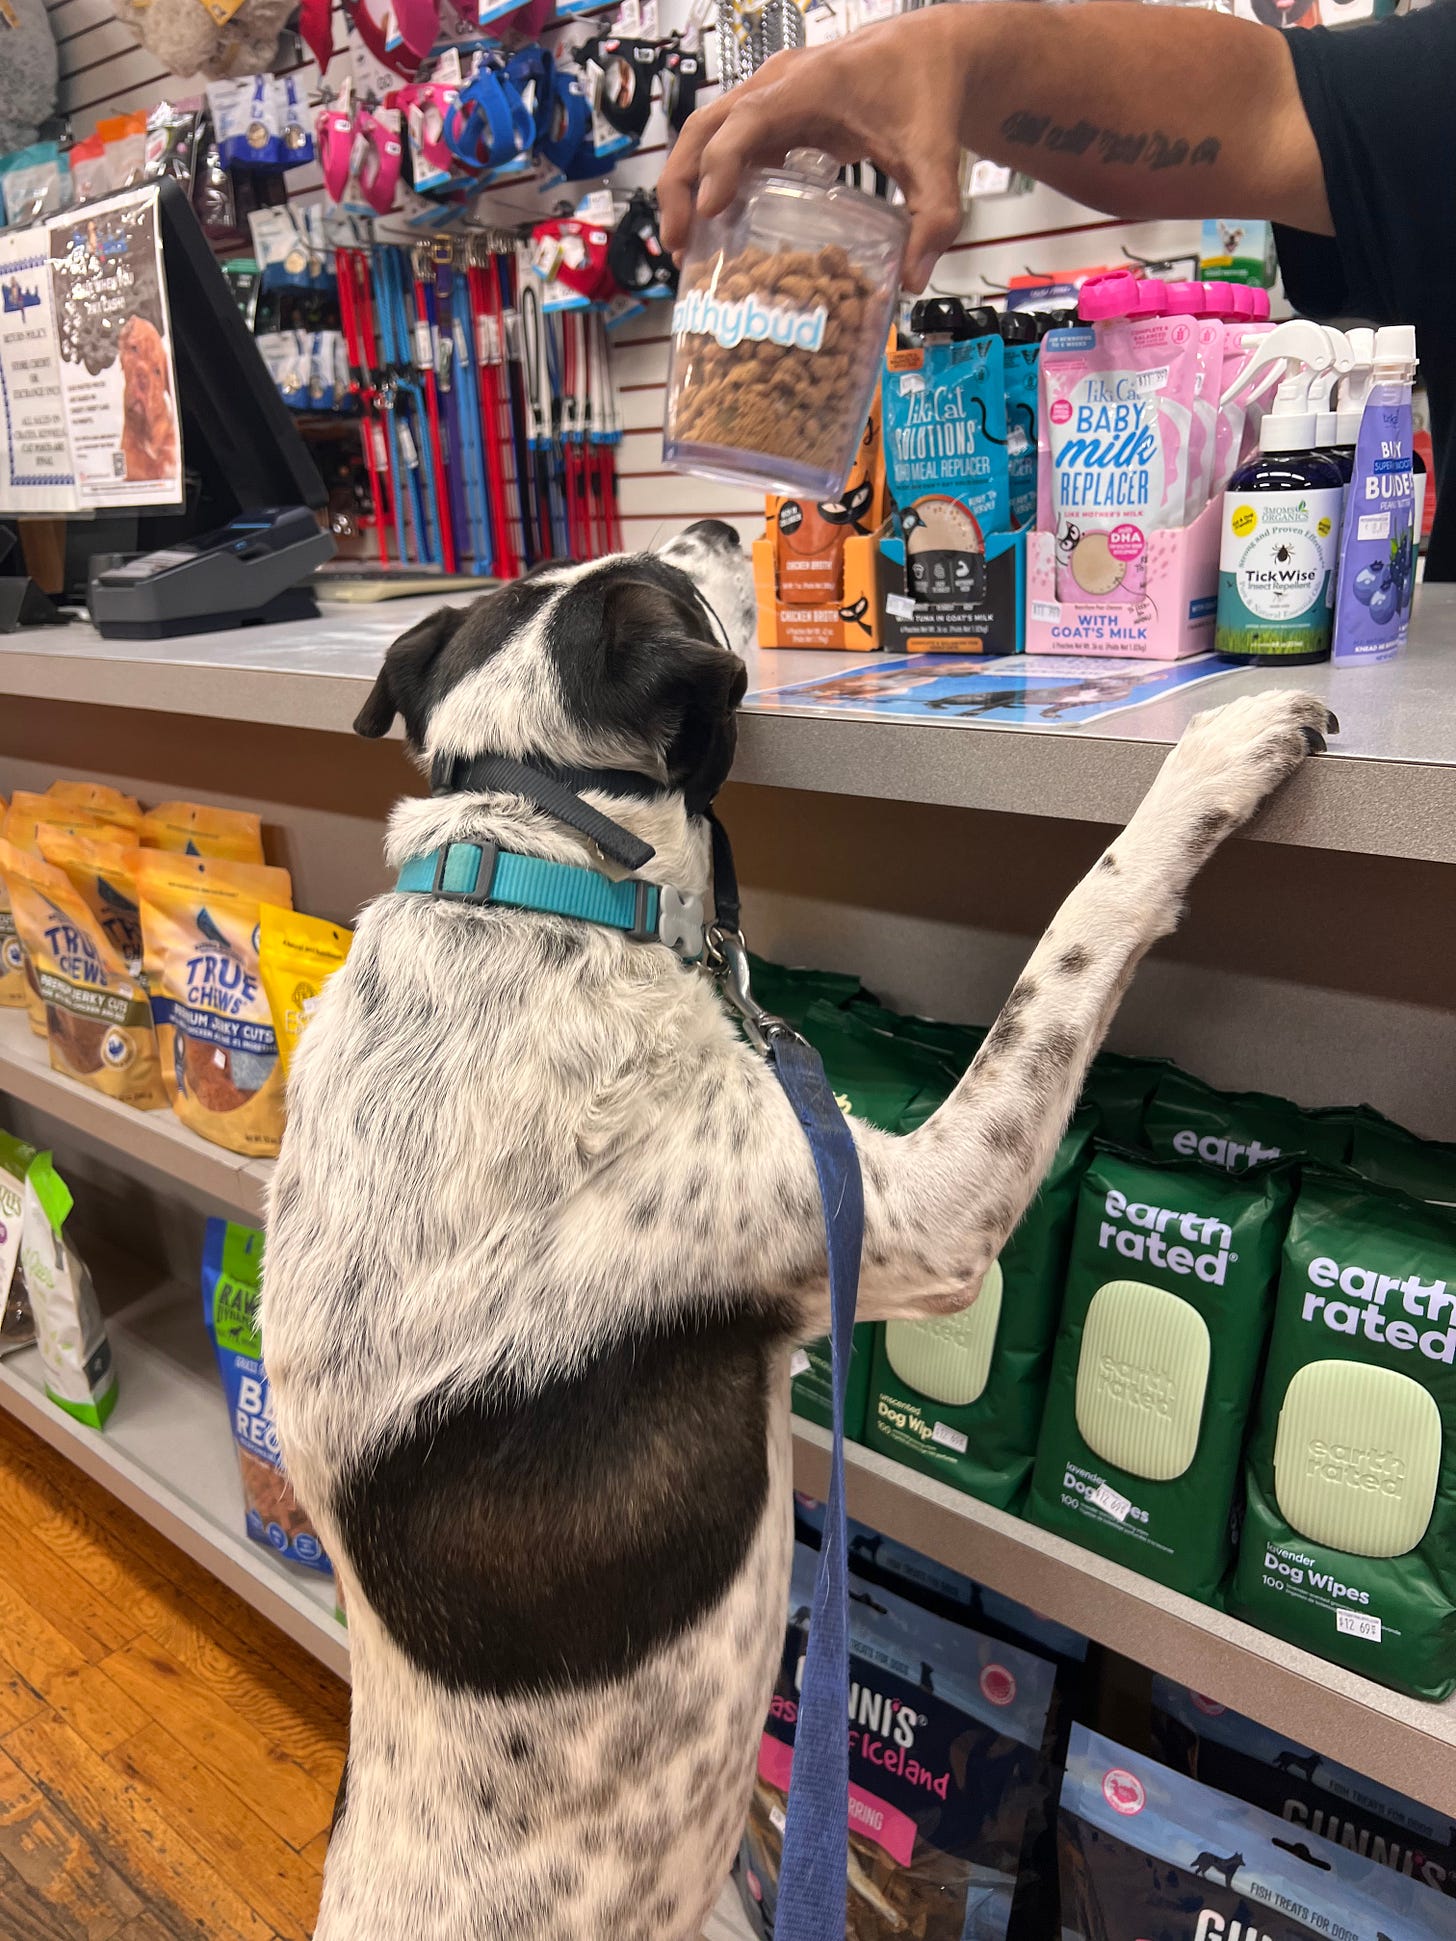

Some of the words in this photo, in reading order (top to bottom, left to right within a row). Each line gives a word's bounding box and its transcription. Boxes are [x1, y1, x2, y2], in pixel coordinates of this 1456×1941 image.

[1086, 379, 1114, 403] Tiki
[1077, 402, 1146, 433] BABY
[895, 421, 976, 460] SOLUTIONS
[1055, 425, 1156, 469] milk
[941, 456, 990, 478] REPLACER
[1060, 470, 1149, 506] REPLACER
[1262, 513, 1309, 521] ORGANICS
[1111, 533, 1141, 543] DHA
[1256, 529, 1270, 543] and
[1272, 526, 1304, 536] Proven
[1272, 581, 1311, 591] Repellent
[780, 611, 812, 623] CHICKEN
[813, 610, 840, 622] BROTH
[1078, 615, 1118, 626] WITH
[1051, 627, 1104, 639] GOAT'S
[1109, 628, 1147, 639] MILK
[44, 925, 97, 960] TRU
[60, 956, 108, 986] CEWS
[187, 955, 257, 1002] TRUE
[243, 1025, 274, 1043] CUTS
[1104, 1190, 1233, 1249] earth
[1098, 1222, 1229, 1286] rated
[1301, 1292, 1456, 1365] rated
[236, 1410, 282, 1454] REC
[877, 1401, 906, 1428] Dog
[908, 1414, 933, 1440] Wip
[1307, 1439, 1407, 1479] earth
[1063, 1472, 1097, 1502] Dog
[1306, 1458, 1402, 1500] rated
[1061, 1493, 1079, 1510] 100
[1266, 1540, 1316, 1567] lavender
[1262, 1574, 1285, 1591] 100
[1264, 1552, 1303, 1583] Dog
[1308, 1570, 1370, 1605] Wipes
[861, 1733, 950, 1800] Iceland
[1250, 1882, 1272, 1902] FISH
[1274, 1893, 1309, 1919] TREATS
[1310, 1911, 1330, 1931] FOR
[1331, 1923, 1359, 1941] DOGS
